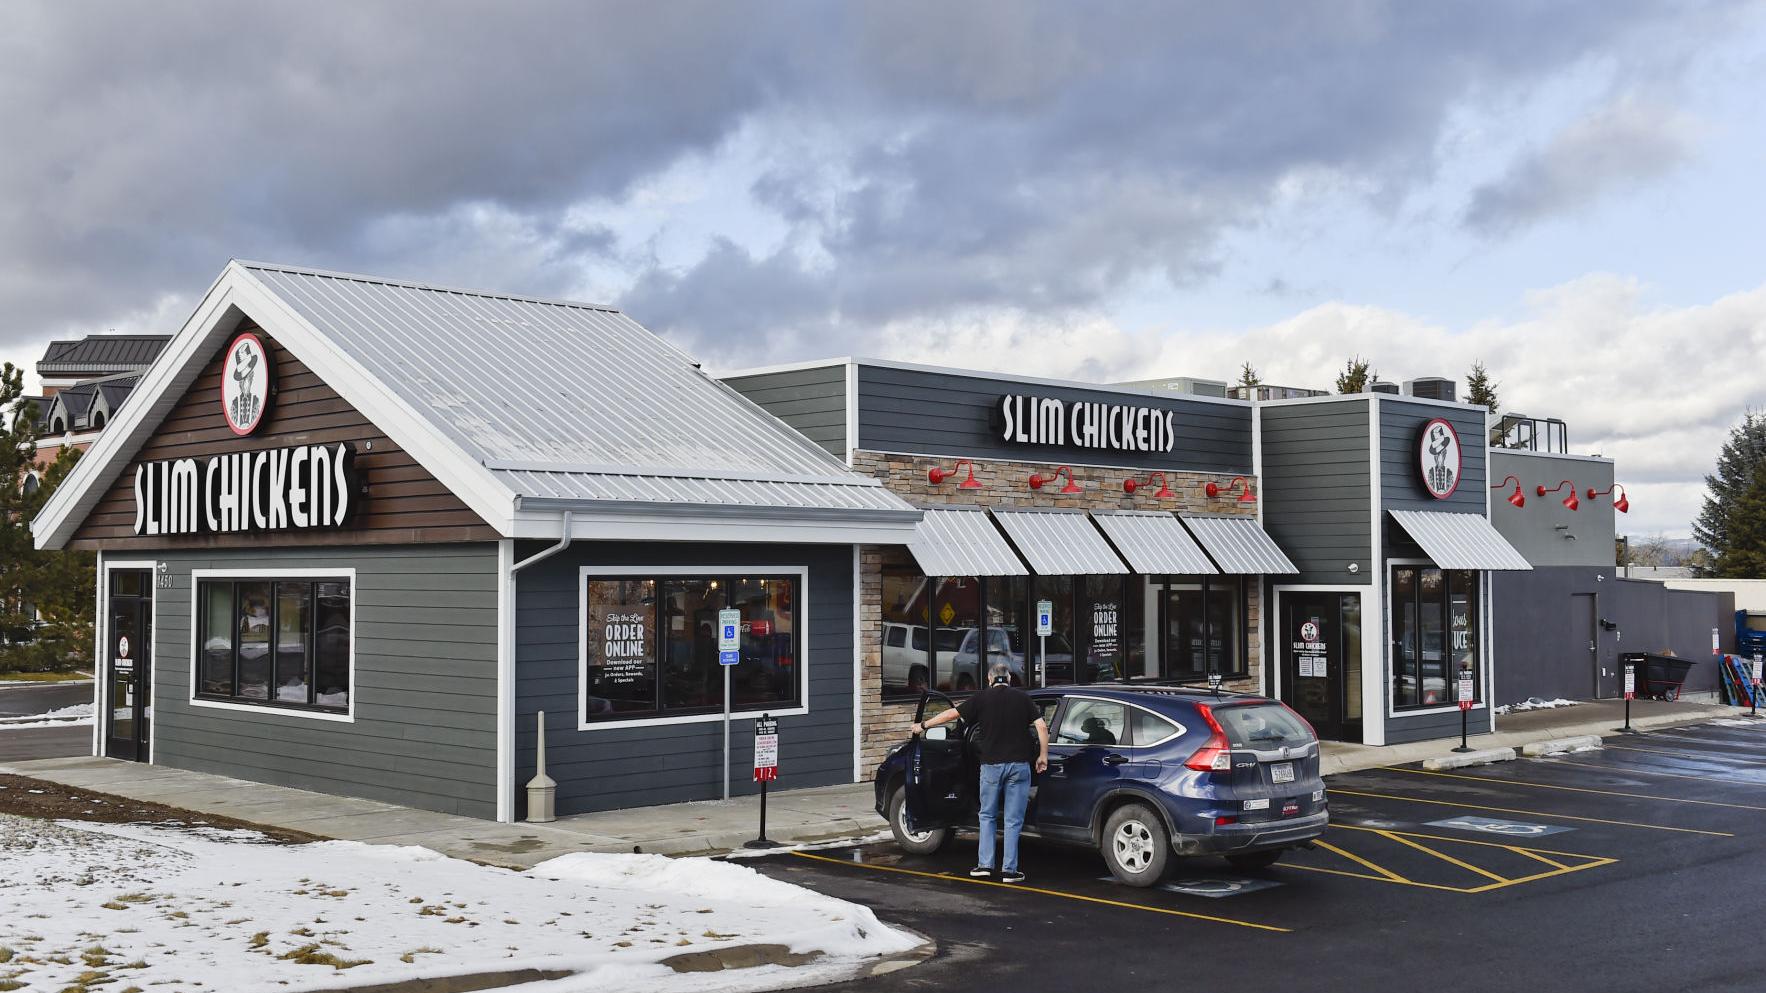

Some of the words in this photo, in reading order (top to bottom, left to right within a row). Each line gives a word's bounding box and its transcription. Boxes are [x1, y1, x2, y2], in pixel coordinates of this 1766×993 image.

[1003, 394, 1064, 445] SLIM
[1071, 402, 1175, 453] CHICKENS
[133, 459, 198, 535] SLIM
[205, 442, 348, 532] CHICKENS
[1094, 611, 1117, 624] ORDER
[606, 624, 644, 640] ORDER
[1094, 624, 1117, 637] ONLINE
[606, 641, 644, 657] ONLINE
